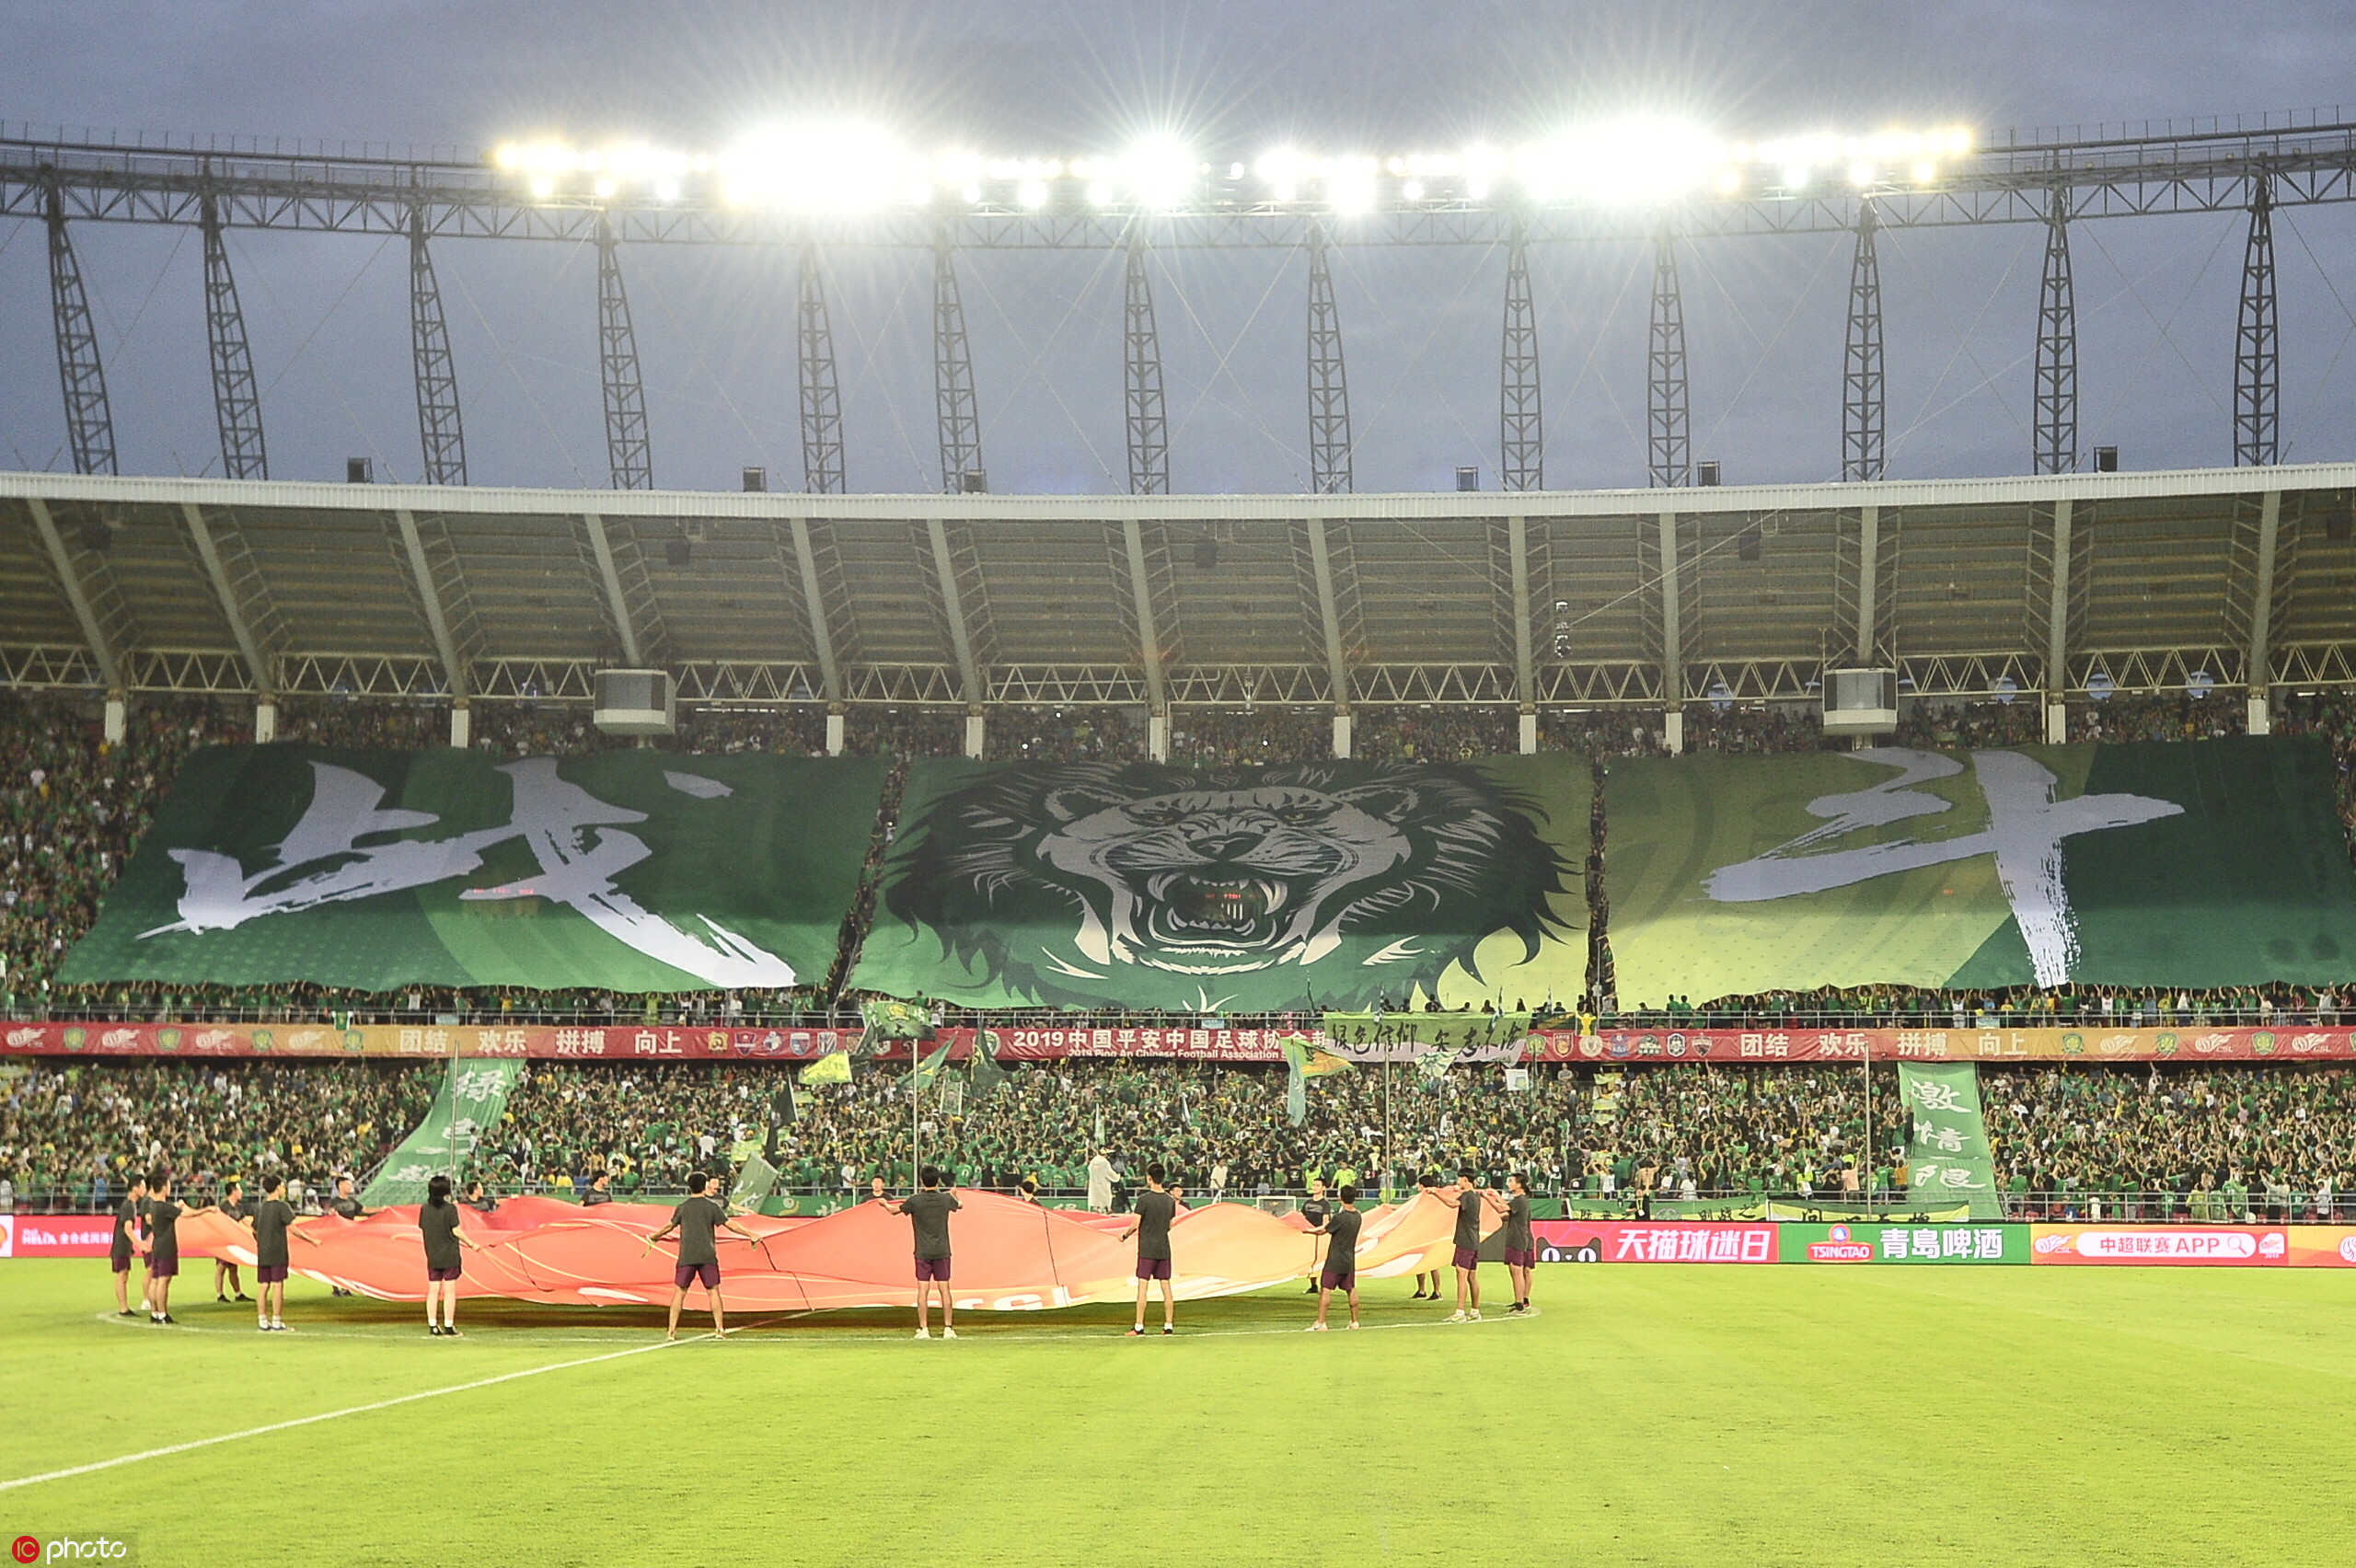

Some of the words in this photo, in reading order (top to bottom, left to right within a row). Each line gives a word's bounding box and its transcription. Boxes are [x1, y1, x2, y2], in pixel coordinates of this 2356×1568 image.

[1699, 746, 2186, 987] 斗
[399, 1030, 448, 1053] 团结
[478, 1030, 526, 1054] 欢乐
[555, 1030, 605, 1055] 拼搏
[634, 1030, 683, 1055] 向上
[1136, 1049, 1175, 1057] Chinese
[1178, 1049, 1218, 1058] Football
[1220, 1050, 1278, 1058] Association
[1740, 1033, 1789, 1056] 团结
[1819, 1032, 1865, 1055] 欢乐
[1898, 1032, 1947, 1055] 拼搏
[1978, 1033, 2027, 1055] 向上
[1616, 1229, 1770, 1261] 天猫球迷日
[1810, 1245, 1870, 1259] TSINGTAO
[1880, 1228, 2003, 1259] 青岛啤酒
[2100, 1237, 2170, 1253] 中超联赛
[2176, 1238, 2220, 1253] APP
